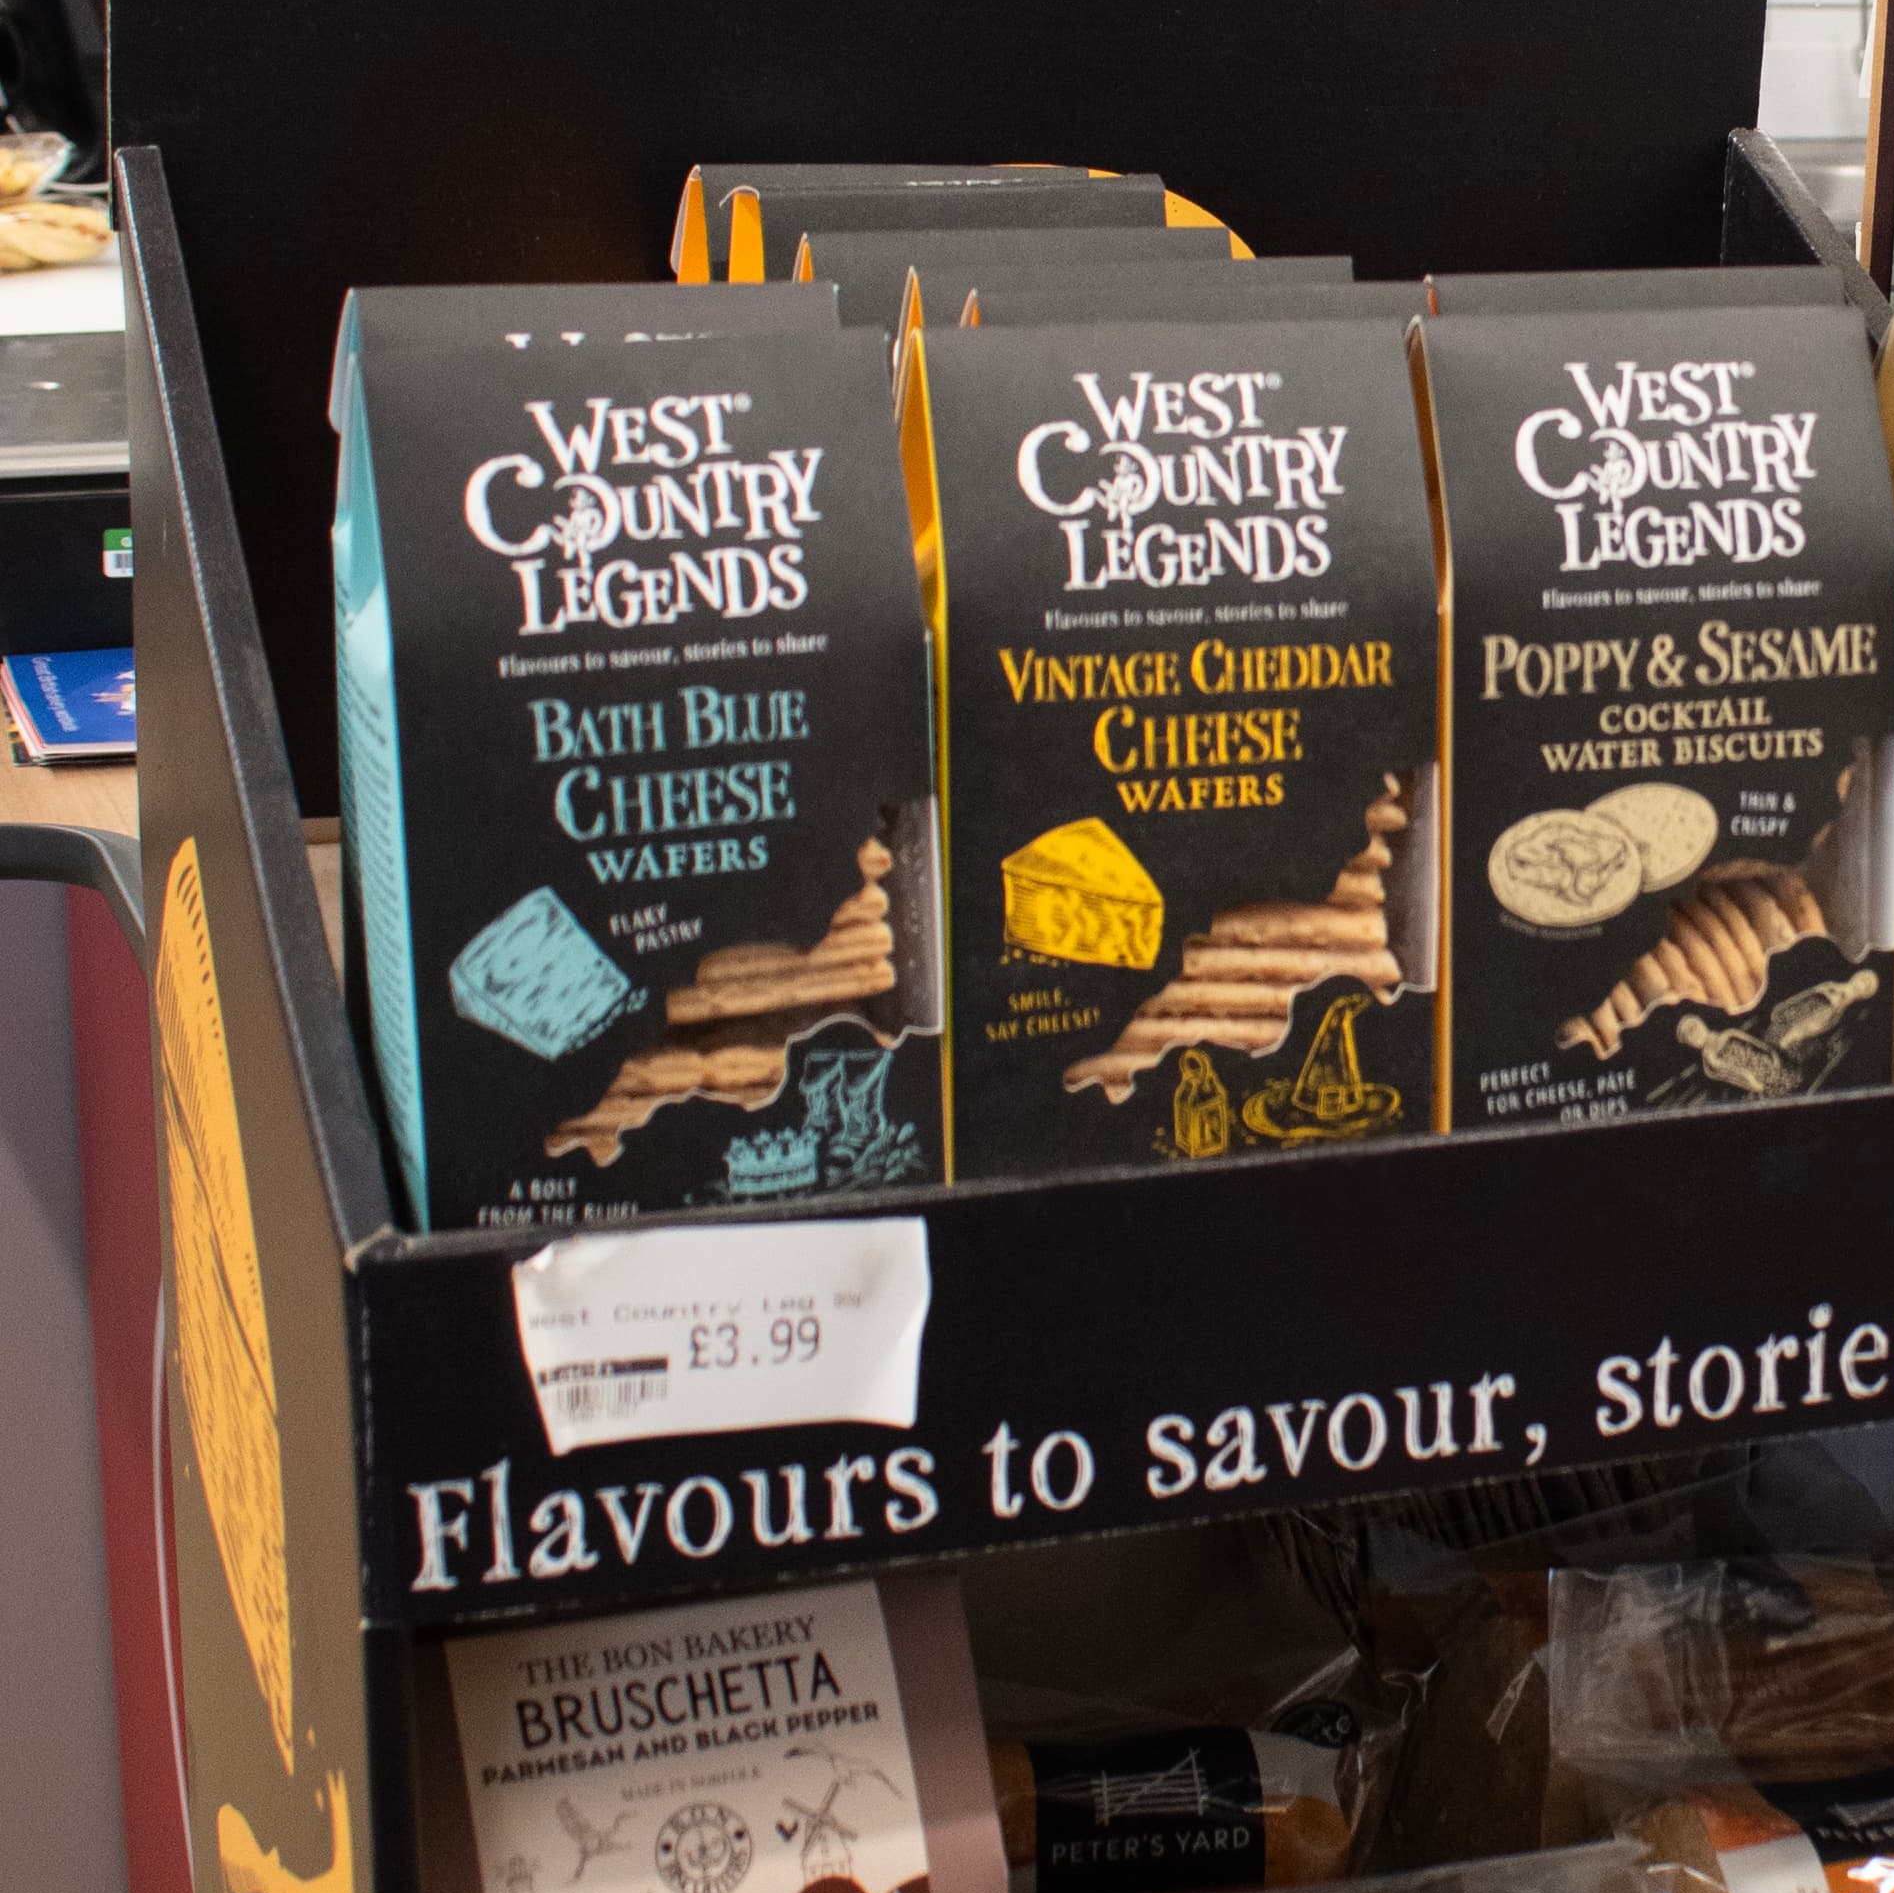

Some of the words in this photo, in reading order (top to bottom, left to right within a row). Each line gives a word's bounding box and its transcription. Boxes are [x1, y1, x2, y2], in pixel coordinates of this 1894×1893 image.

[1017, 420, 1348, 516] COUNTRY
[1515, 407, 1818, 500] COUNTRY
[464, 448, 825, 558] COUNTRY
[1555, 498, 1806, 571] LEGENDS
[1059, 515, 1331, 591] LEGENDS
[510, 545, 808, 635] LEGENDS
[999, 648, 1181, 704] VINTAGE
[1190, 638, 1393, 695] CHEDDAR
[1480, 634, 1640, 700] POPPY
[1647, 634, 1688, 688] &
[1696, 620, 1878, 687] SESAME
[528, 696, 666, 762] BATH
[679, 685, 809, 750] BLUE
[1093, 705, 1303, 774] CHEESE
[1541, 741, 1661, 772] WATER
[1674, 728, 1823, 766] BISCUITS
[1600, 696, 1771, 734] COCKTAIL
[554, 762, 796, 842] CHEESE
[1117, 773, 1285, 814] WAFERS
[587, 836, 769, 884] WAFERS
[610, 904, 668, 936] FLAKY
[635, 918, 702, 954] PASTRY
[688, 1315, 821, 1372] £3.99
[407, 1445, 939, 1592] Flavours
[981, 1420, 1094, 1518] to
[1146, 1371, 1549, 1501] savour,
[518, 1647, 590, 1688] THE
[600, 1637, 673, 1676] BON
[684, 1616, 816, 1660] BAKERY
[516, 1652, 843, 1751] BRUSCHETTA
[481, 1747, 625, 1788] PARMESAN
[633, 1735, 690, 1767] AND
[694, 1718, 779, 1754] BLACK
[786, 1702, 879, 1736] PEPPER
[1050, 1831, 1165, 1865] PETER'S
[1173, 1825, 1251, 1856] YARD
